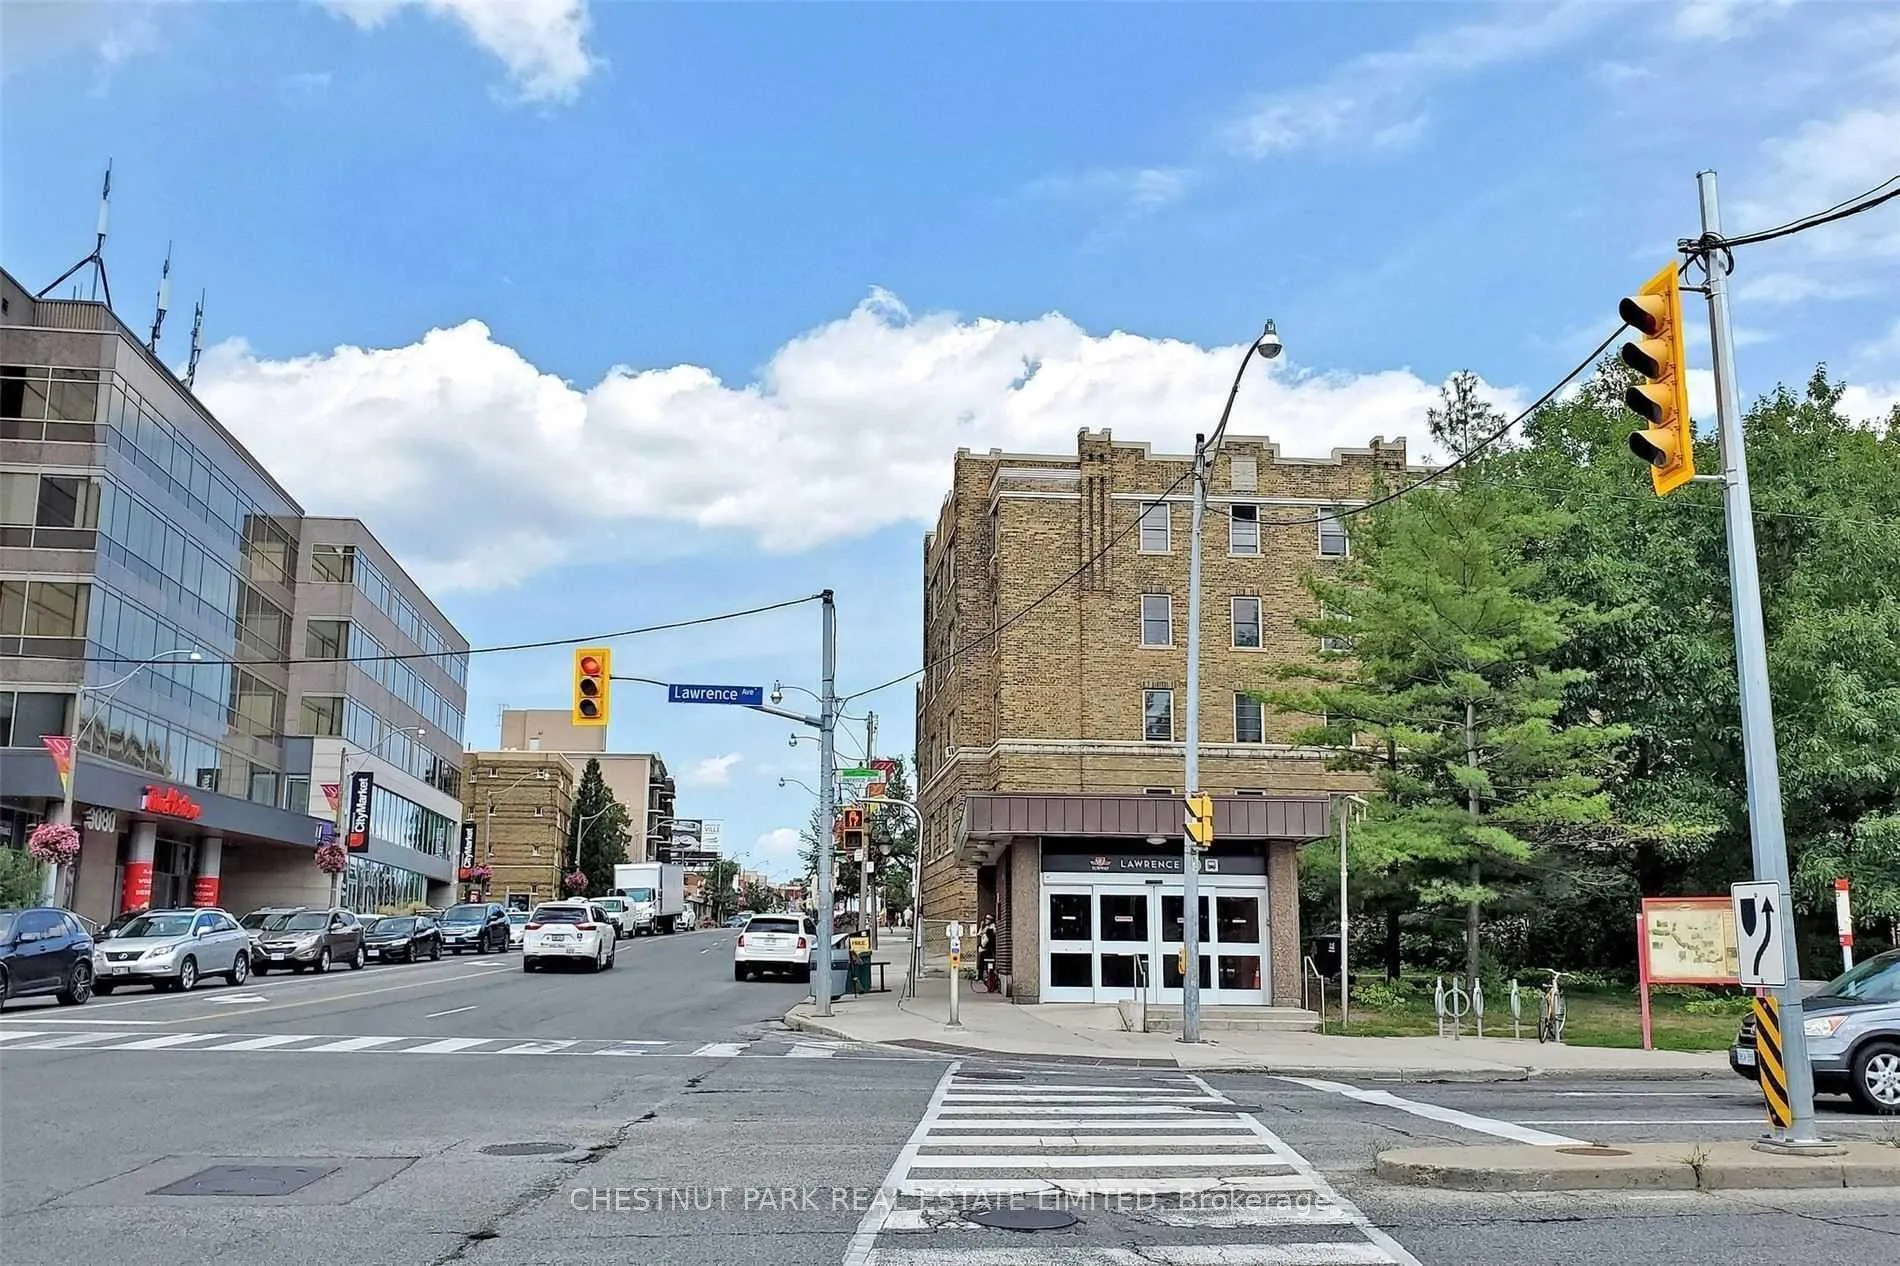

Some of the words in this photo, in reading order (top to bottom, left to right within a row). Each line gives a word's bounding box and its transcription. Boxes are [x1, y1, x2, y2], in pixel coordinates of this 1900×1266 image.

[674, 686, 738, 700] Lawrence
[354, 777, 369, 833] CityMarket
[83, 807, 116, 833] 3080
[1120, 858, 1180, 869] LAWRENCE
